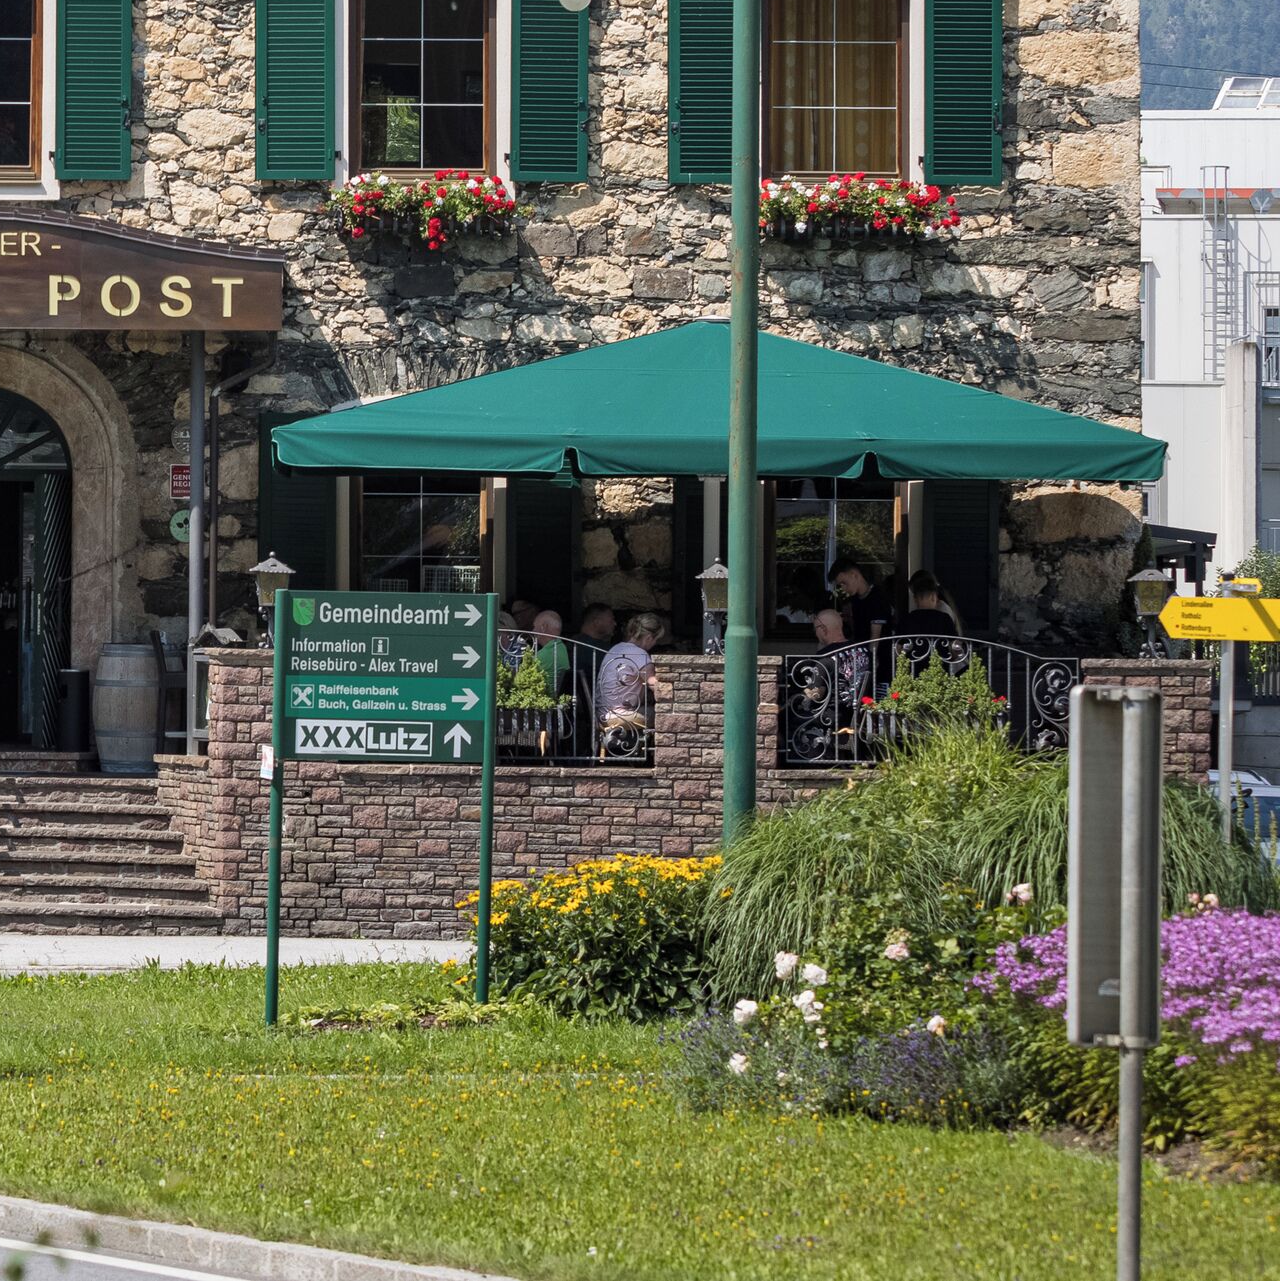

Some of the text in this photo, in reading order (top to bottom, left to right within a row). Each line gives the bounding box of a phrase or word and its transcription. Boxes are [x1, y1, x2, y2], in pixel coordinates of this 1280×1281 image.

[48, 274, 244, 318] POST
[319, 602, 450, 625] Gemeindeamt
[291, 637, 366, 653] Information
[291, 656, 357, 672] Reisebüro
[368, 657, 395, 673] Alex
[398, 658, 438, 673] Travel
[318, 684, 399, 696] Raiffeisenbank
[318, 698, 349, 710] Buch,
[398, 702, 408, 710] u.
[411, 700, 447, 711] Strass
[299, 724, 429, 751] XXXLutz
